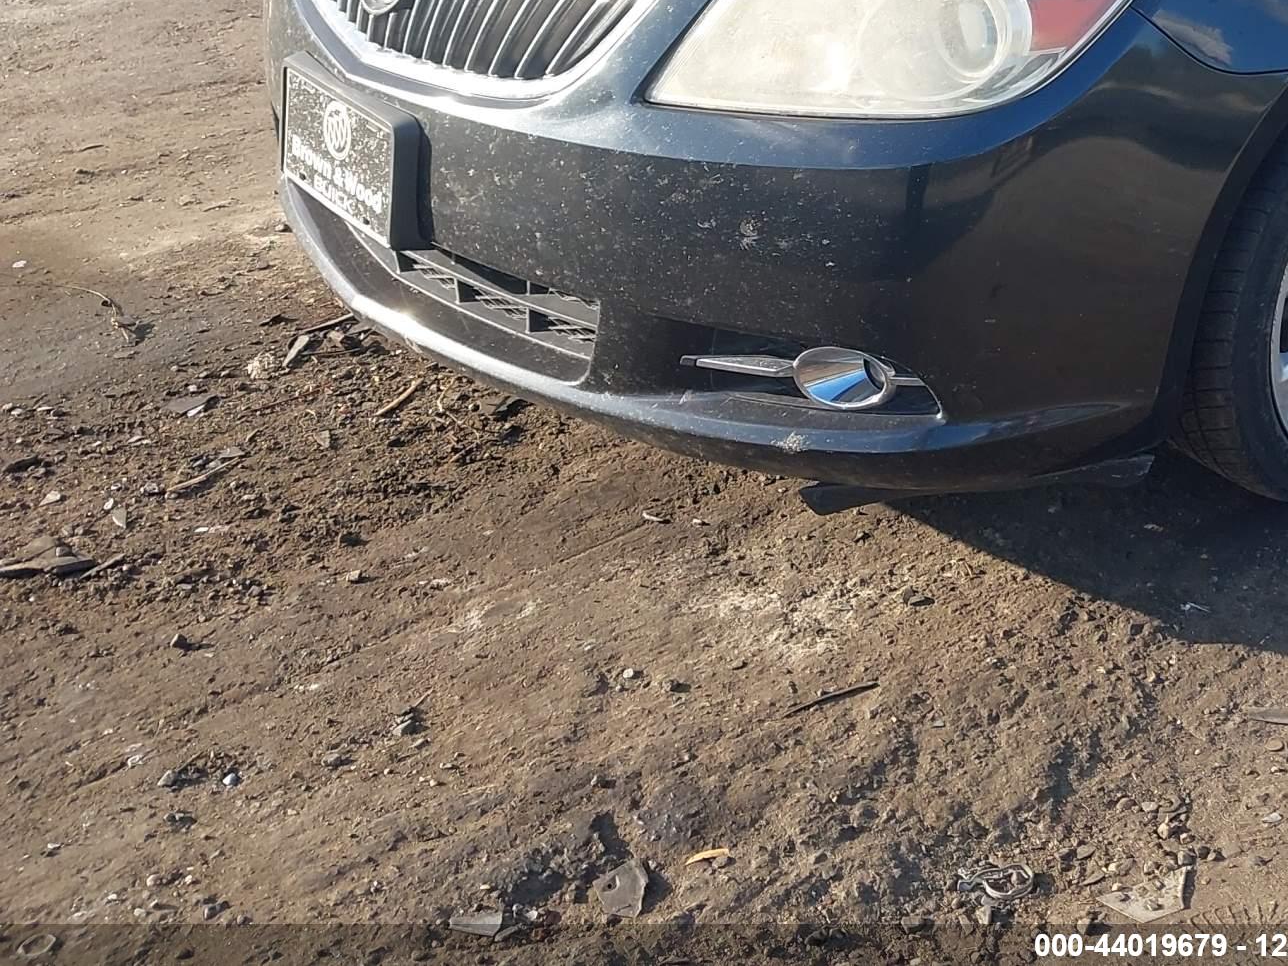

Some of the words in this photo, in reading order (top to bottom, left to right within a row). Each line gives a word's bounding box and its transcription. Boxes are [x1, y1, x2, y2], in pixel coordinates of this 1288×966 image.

[292, 134, 332, 180] Brown
[333, 166, 344, 188] &
[344, 167, 382, 214] Wood
[314, 172, 353, 214] BUICK
